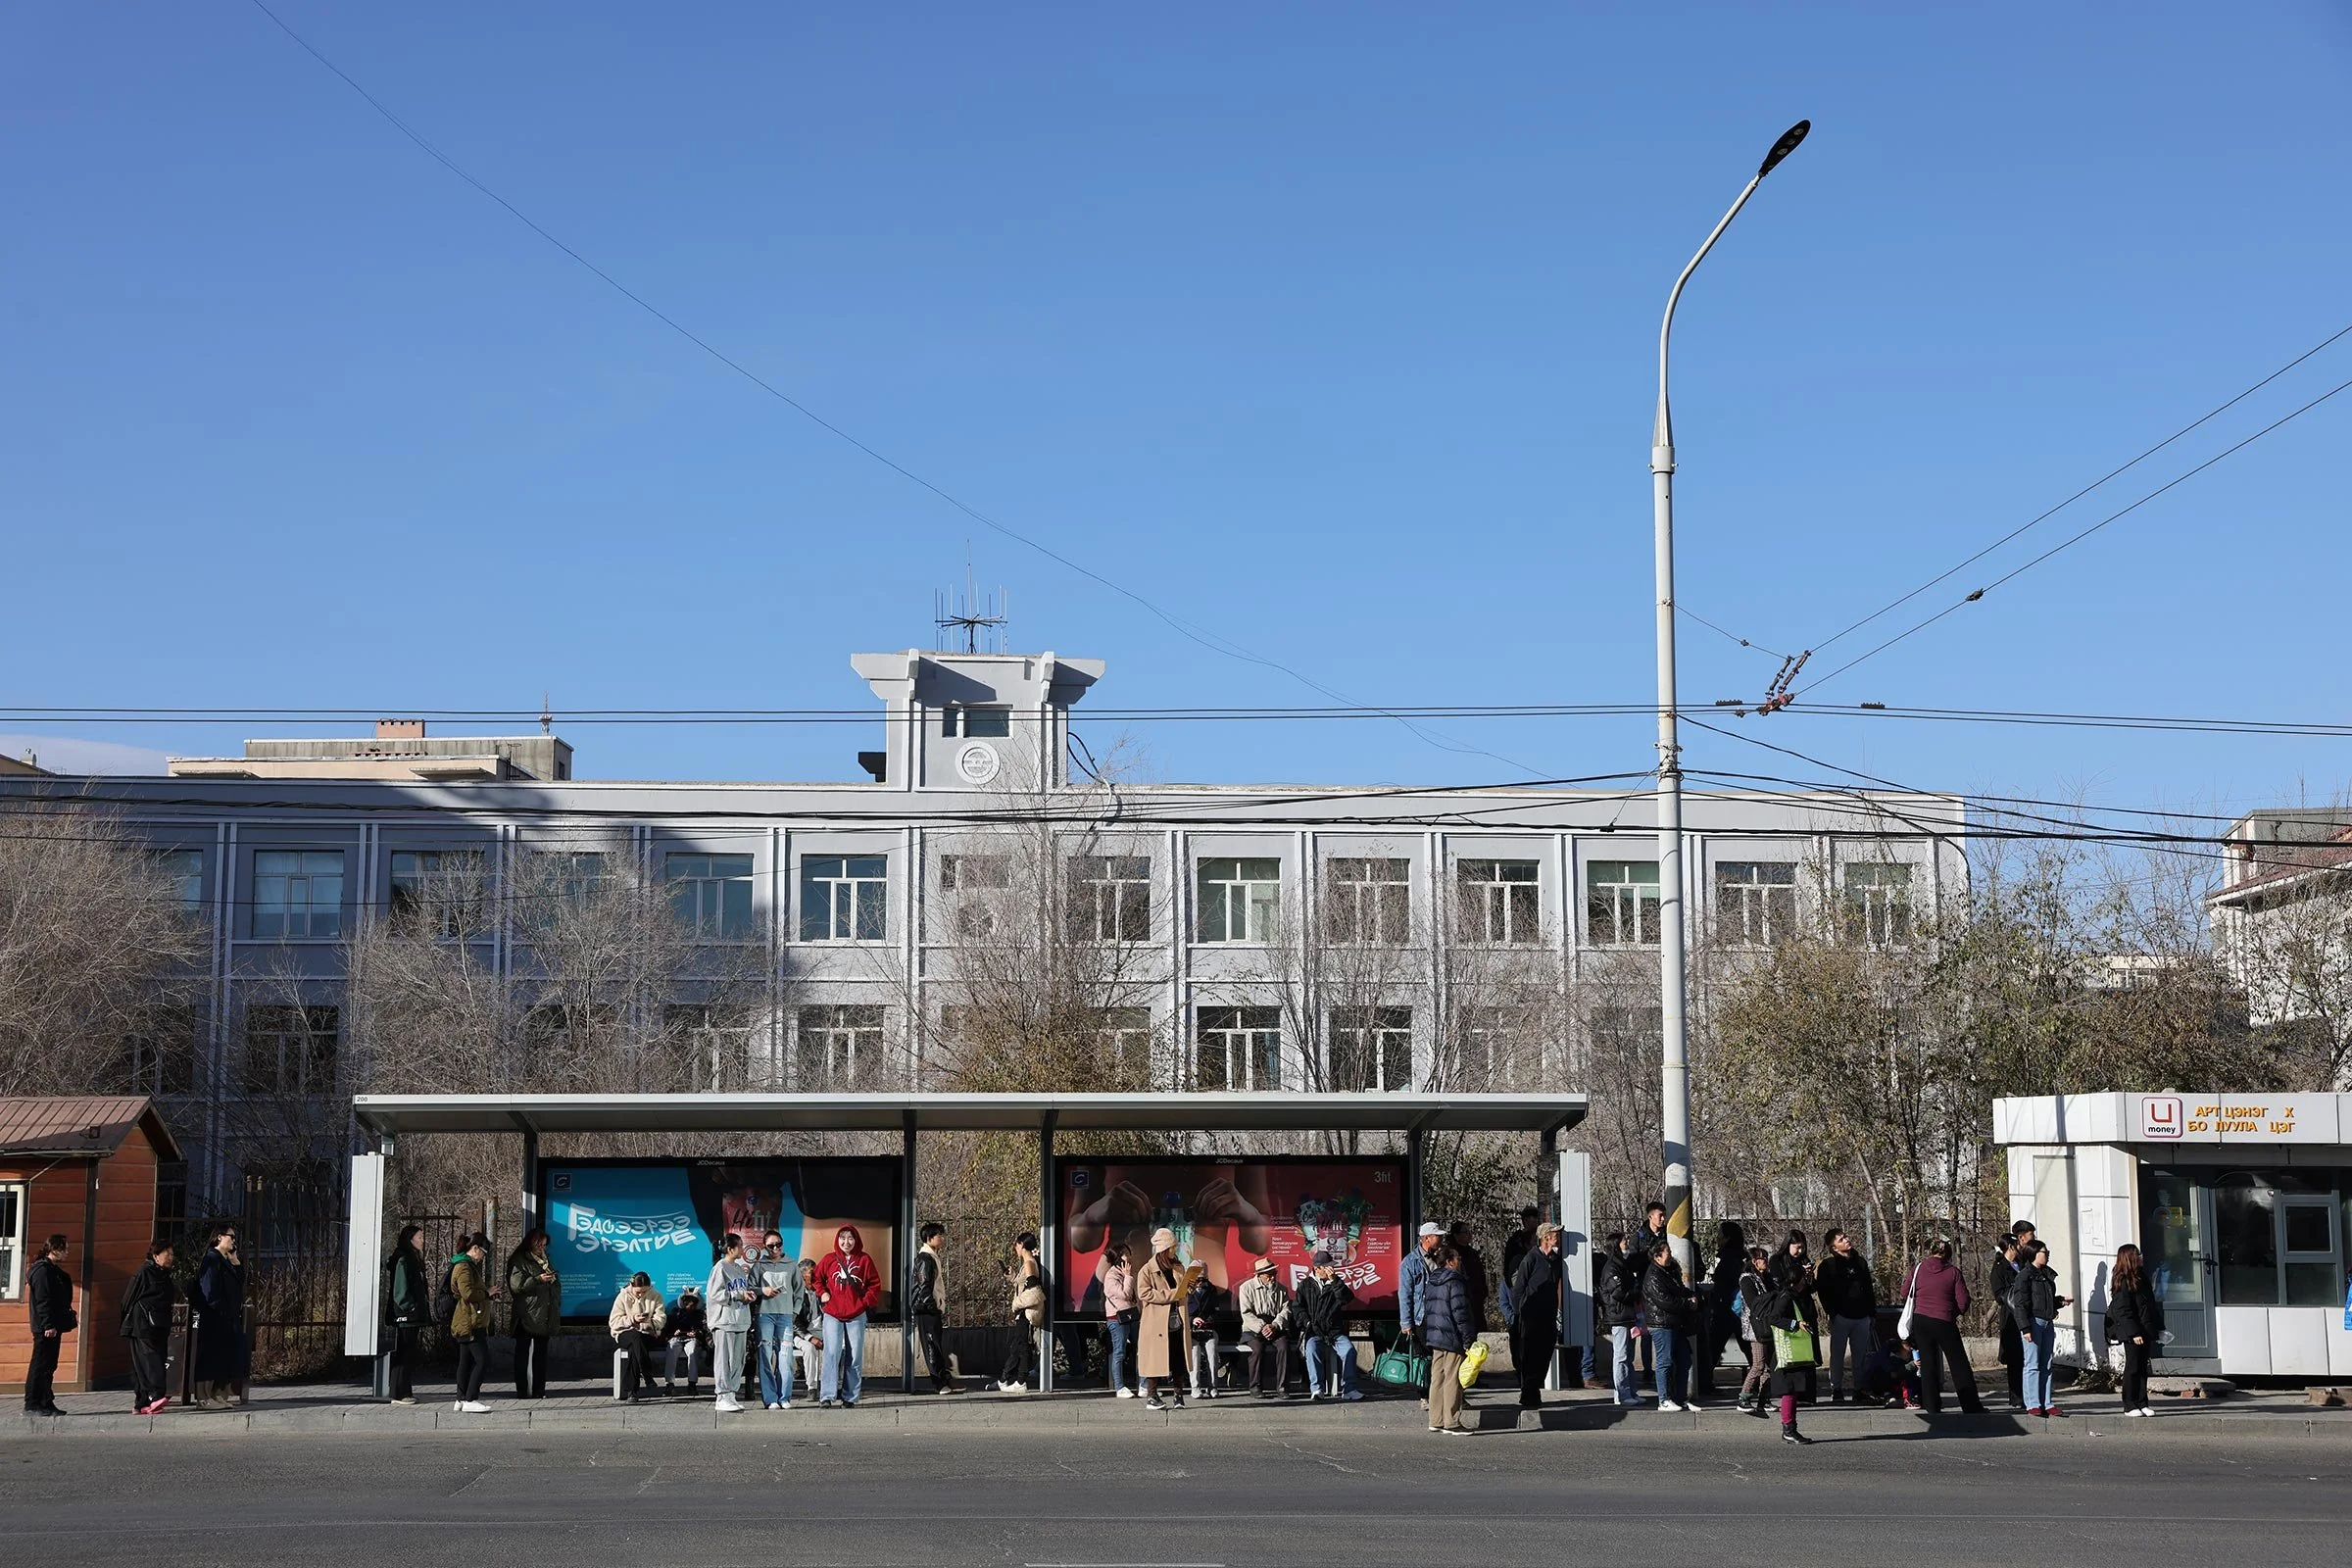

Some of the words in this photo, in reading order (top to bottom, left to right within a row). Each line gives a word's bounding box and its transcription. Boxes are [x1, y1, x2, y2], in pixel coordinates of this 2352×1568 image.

[2195, 1105, 2221, 1118] АРТ
[2225, 1106, 2269, 1119] ЦЭНЭГ
[2148, 1126, 2177, 1135] money
[2269, 1121, 2295, 1134] ЦЭГ
[1374, 1170, 1392, 1183] 3fit
